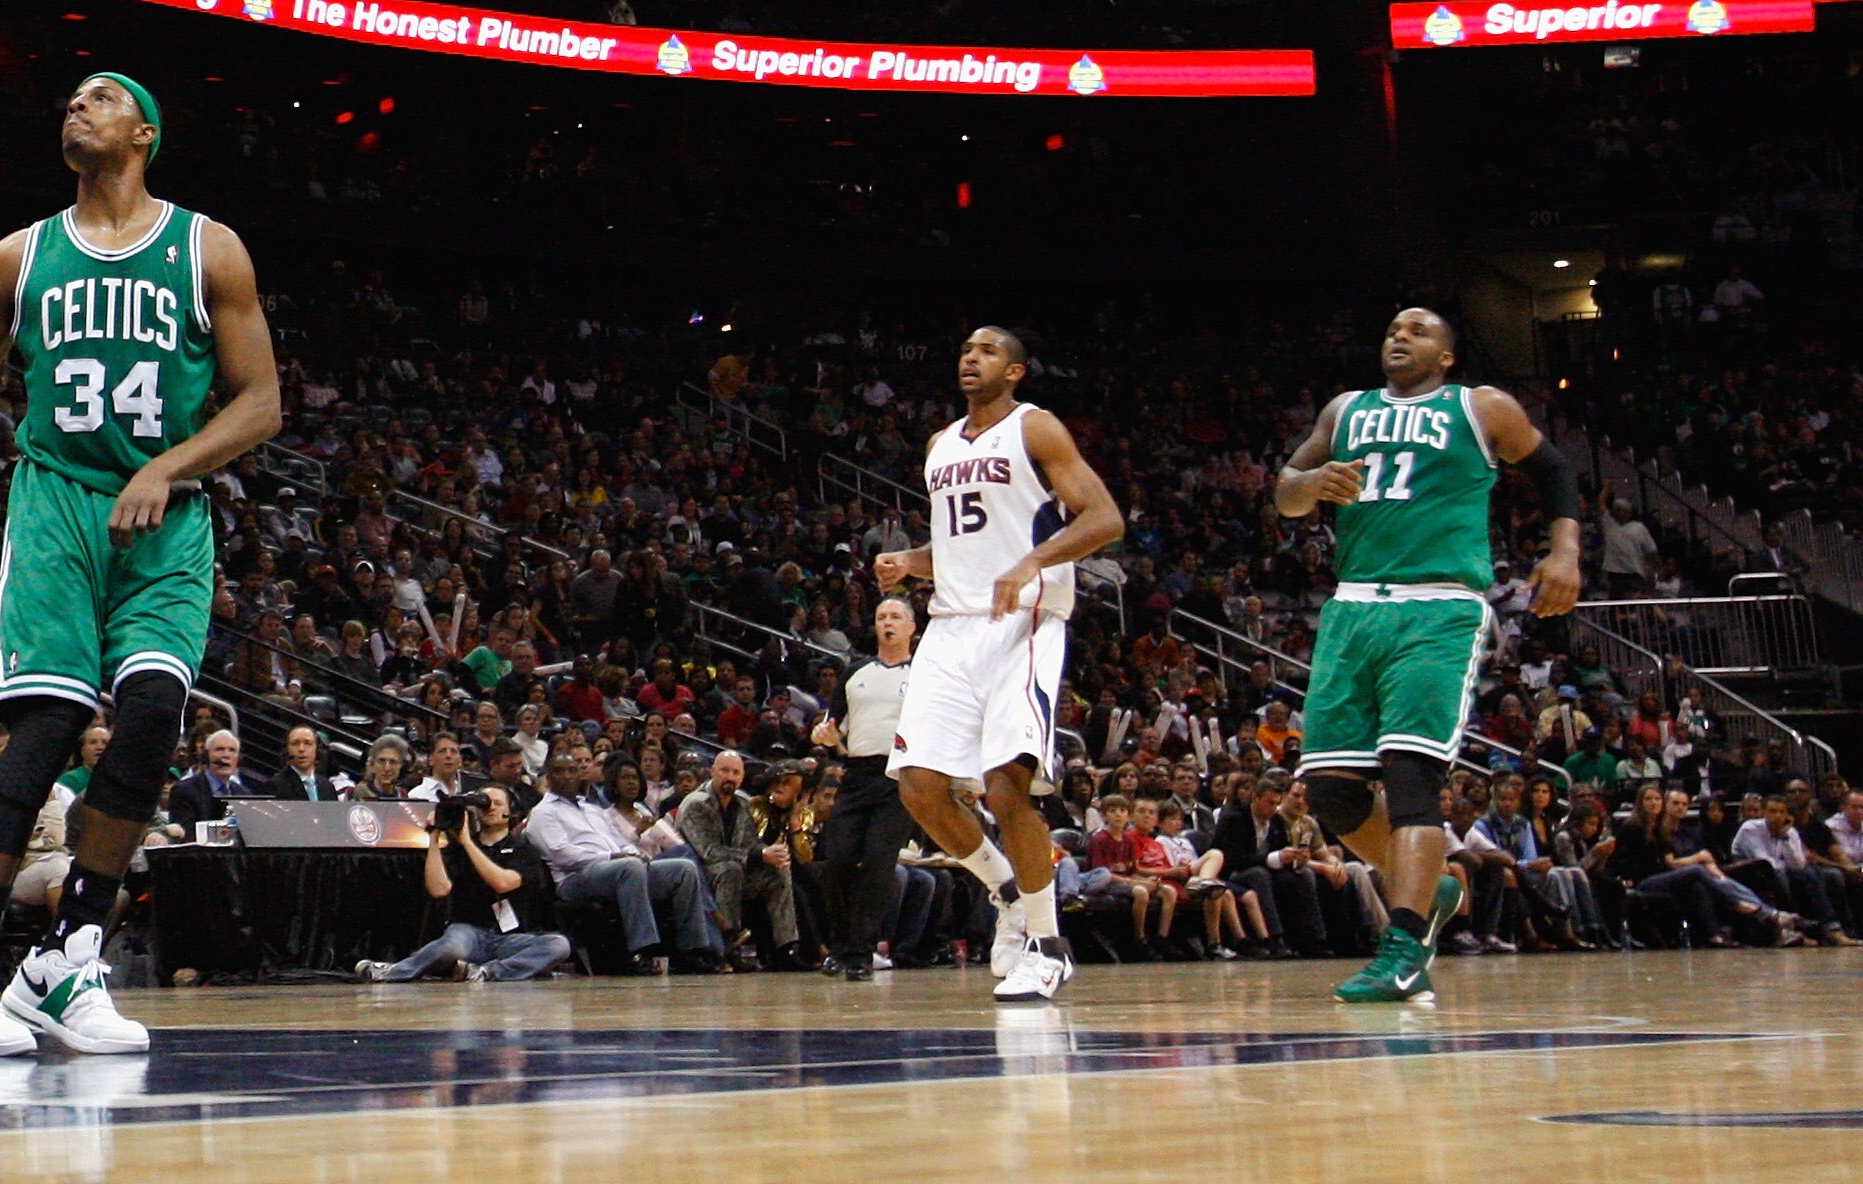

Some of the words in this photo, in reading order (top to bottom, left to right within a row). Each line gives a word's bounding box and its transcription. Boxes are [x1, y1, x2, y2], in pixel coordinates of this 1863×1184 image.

[352, 1, 472, 45] Honest
[476, 17, 617, 61] Plumber
[711, 39, 861, 81] Superior
[867, 51, 1042, 92] Plumbing
[41, 277, 178, 352] CELTICS
[897, 344, 928, 361] 107
[54, 358, 164, 438] 34
[1347, 405, 1452, 452] CELTICS
[929, 457, 1011, 495] HAWKS
[1358, 451, 1415, 503] 11
[946, 491, 988, 538] 15
